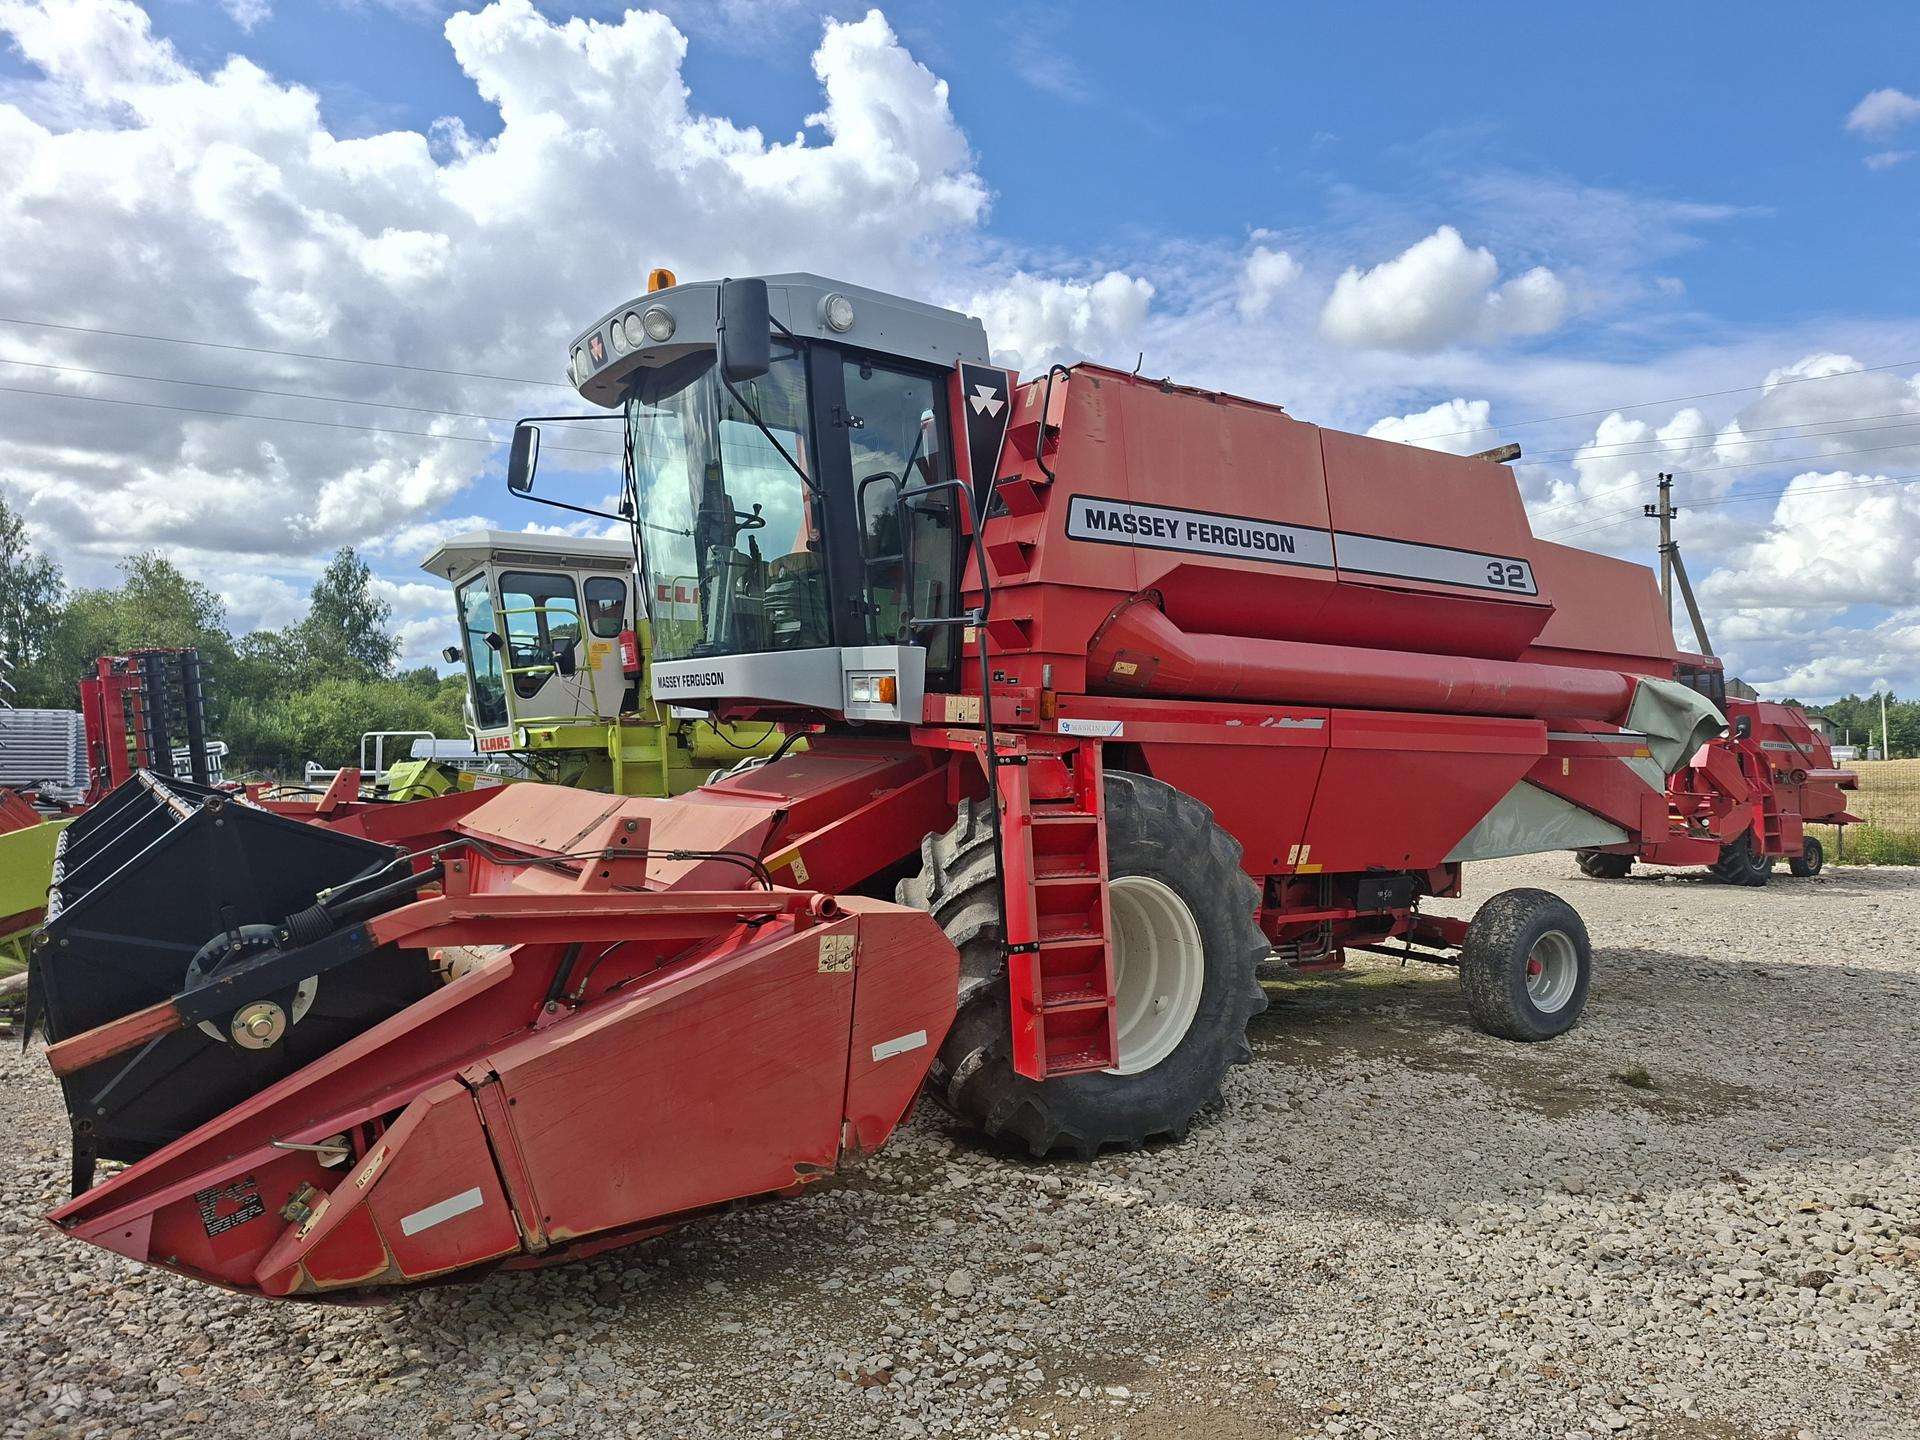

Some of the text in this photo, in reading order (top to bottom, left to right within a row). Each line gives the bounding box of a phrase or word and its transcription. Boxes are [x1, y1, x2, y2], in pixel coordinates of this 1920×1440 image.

[1085, 508, 1296, 554] MASSEY FERGUSON
[1486, 561, 1527, 588] 32
[657, 671, 725, 689] MASSEY FERGUSON
[480, 735, 511, 751] CLAAS
